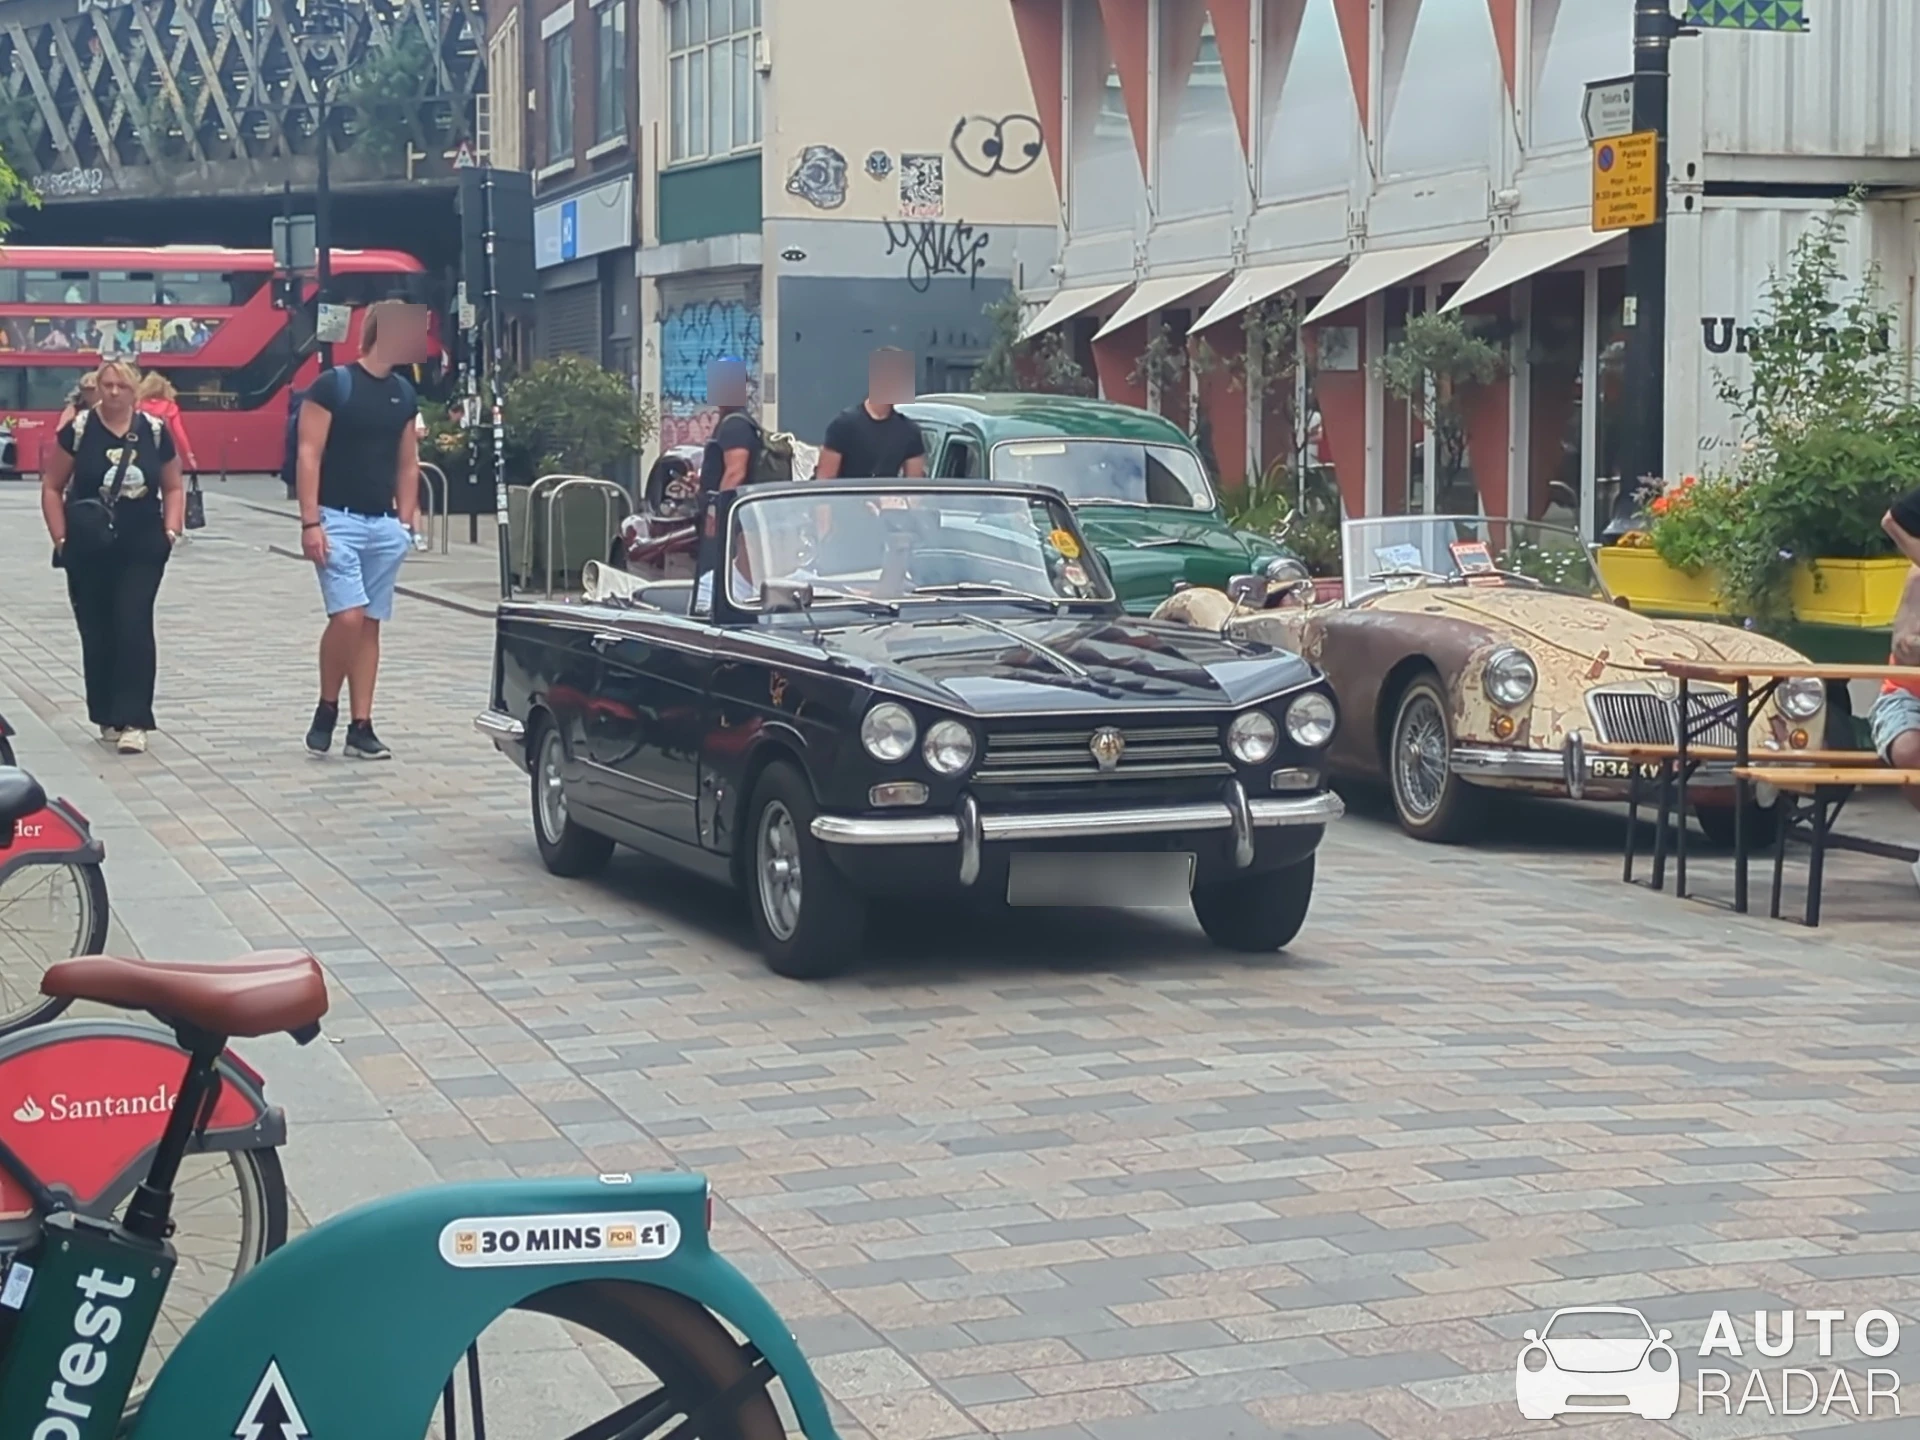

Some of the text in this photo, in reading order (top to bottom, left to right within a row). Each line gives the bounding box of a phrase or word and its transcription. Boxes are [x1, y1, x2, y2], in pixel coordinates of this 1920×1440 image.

[1593, 761, 1630, 777] 834
[459, 1243, 474, 1252] TO
[482, 1229, 521, 1254] 30
[526, 1226, 601, 1252] MINS
[609, 1231, 634, 1242] FOR
